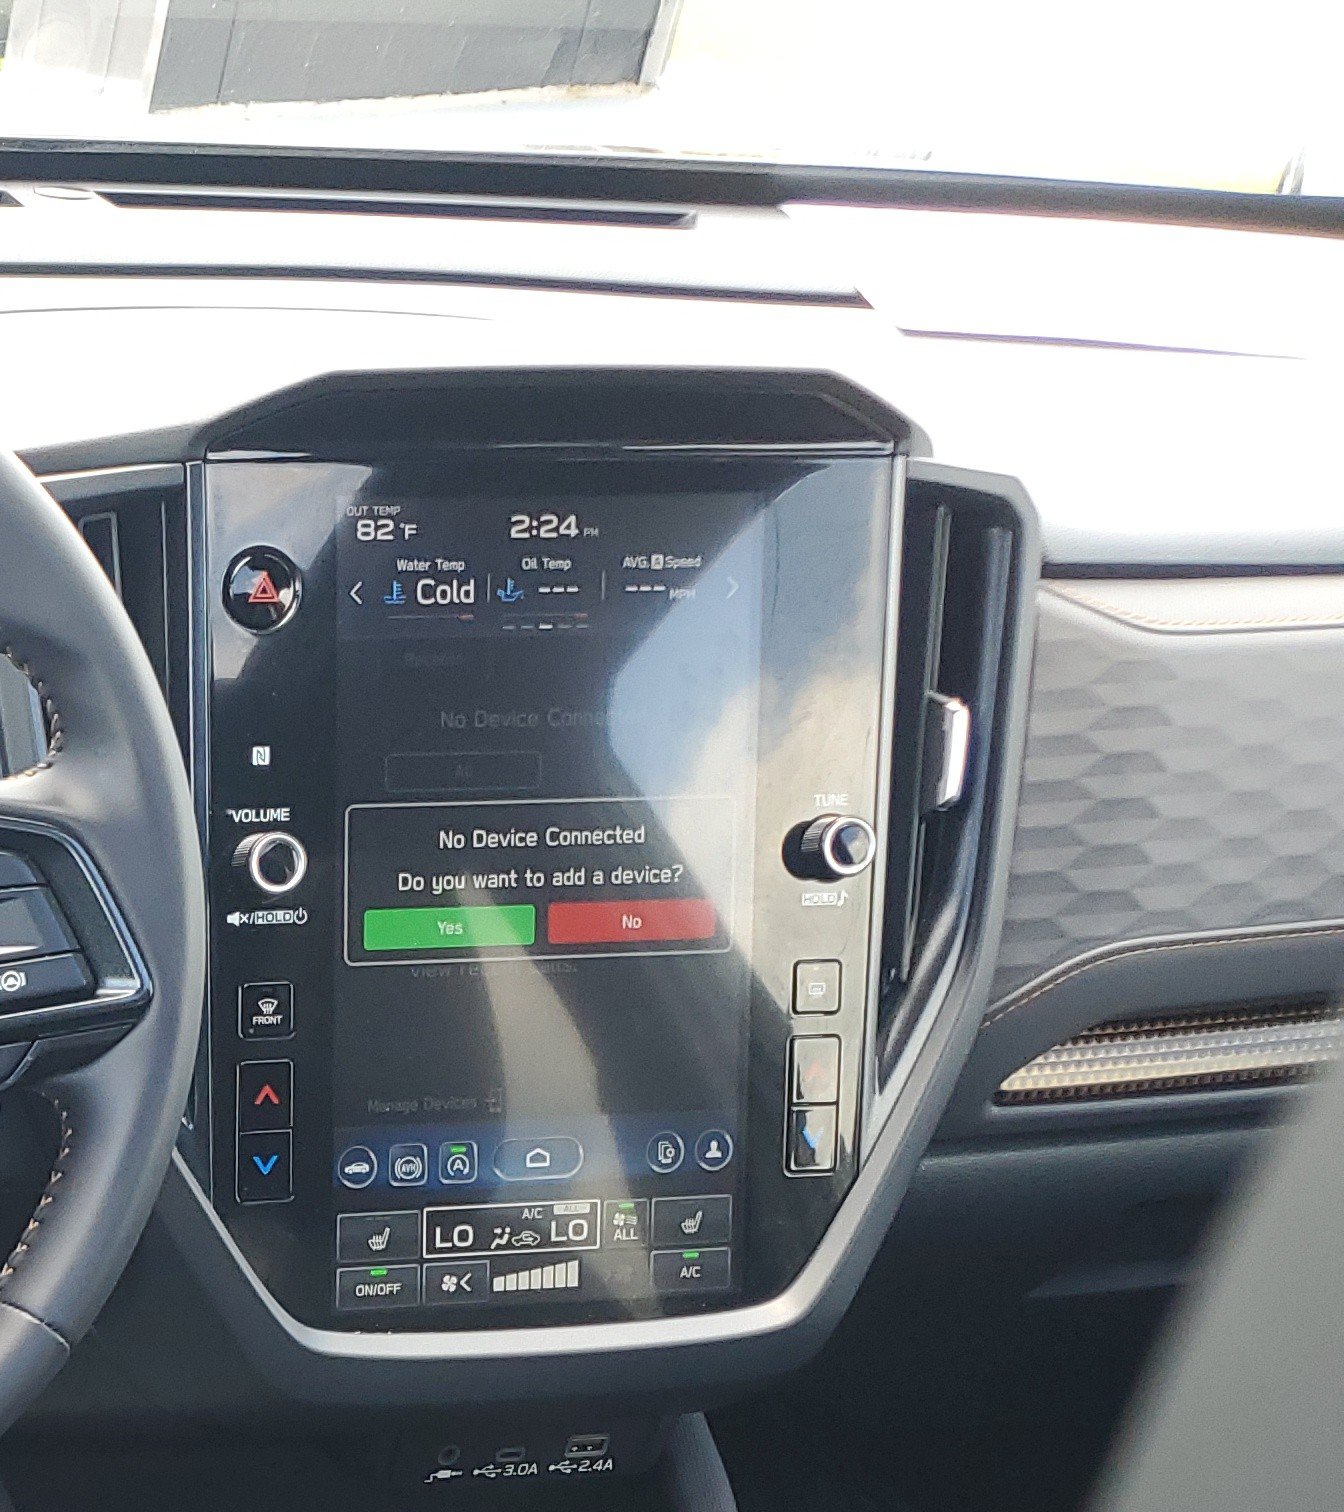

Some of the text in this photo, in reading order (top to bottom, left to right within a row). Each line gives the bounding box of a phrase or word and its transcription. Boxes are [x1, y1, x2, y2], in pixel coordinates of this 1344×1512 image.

[346, 505, 401, 517] OUT TEMP
[356, 519, 395, 541] 82
[510, 513, 580, 539] 2:24
[396, 558, 465, 573] Water Temp
[521, 557, 572, 573] Oil Temp
[415, 578, 476, 606] Cold
[231, 807, 291, 823] VOLUME
[439, 825, 646, 850] No Device Connected
[398, 864, 684, 895] Do you want to add a device?
[255, 911, 293, 924] HOLD
[621, 915, 642, 930] No
[436, 920, 463, 936] Yes
[252, 1015, 283, 1026] FRONT
[521, 1207, 543, 1220] A/C
[435, 1224, 474, 1248] LO
[550, 1219, 589, 1243] LO
[613, 1227, 638, 1240] ALL
[679, 1265, 701, 1279] A/C
[355, 1282, 402, 1298] ON/OFF
[502, 1463, 538, 1476] 3.0A
[577, 1459, 614, 1472] 2.4A
